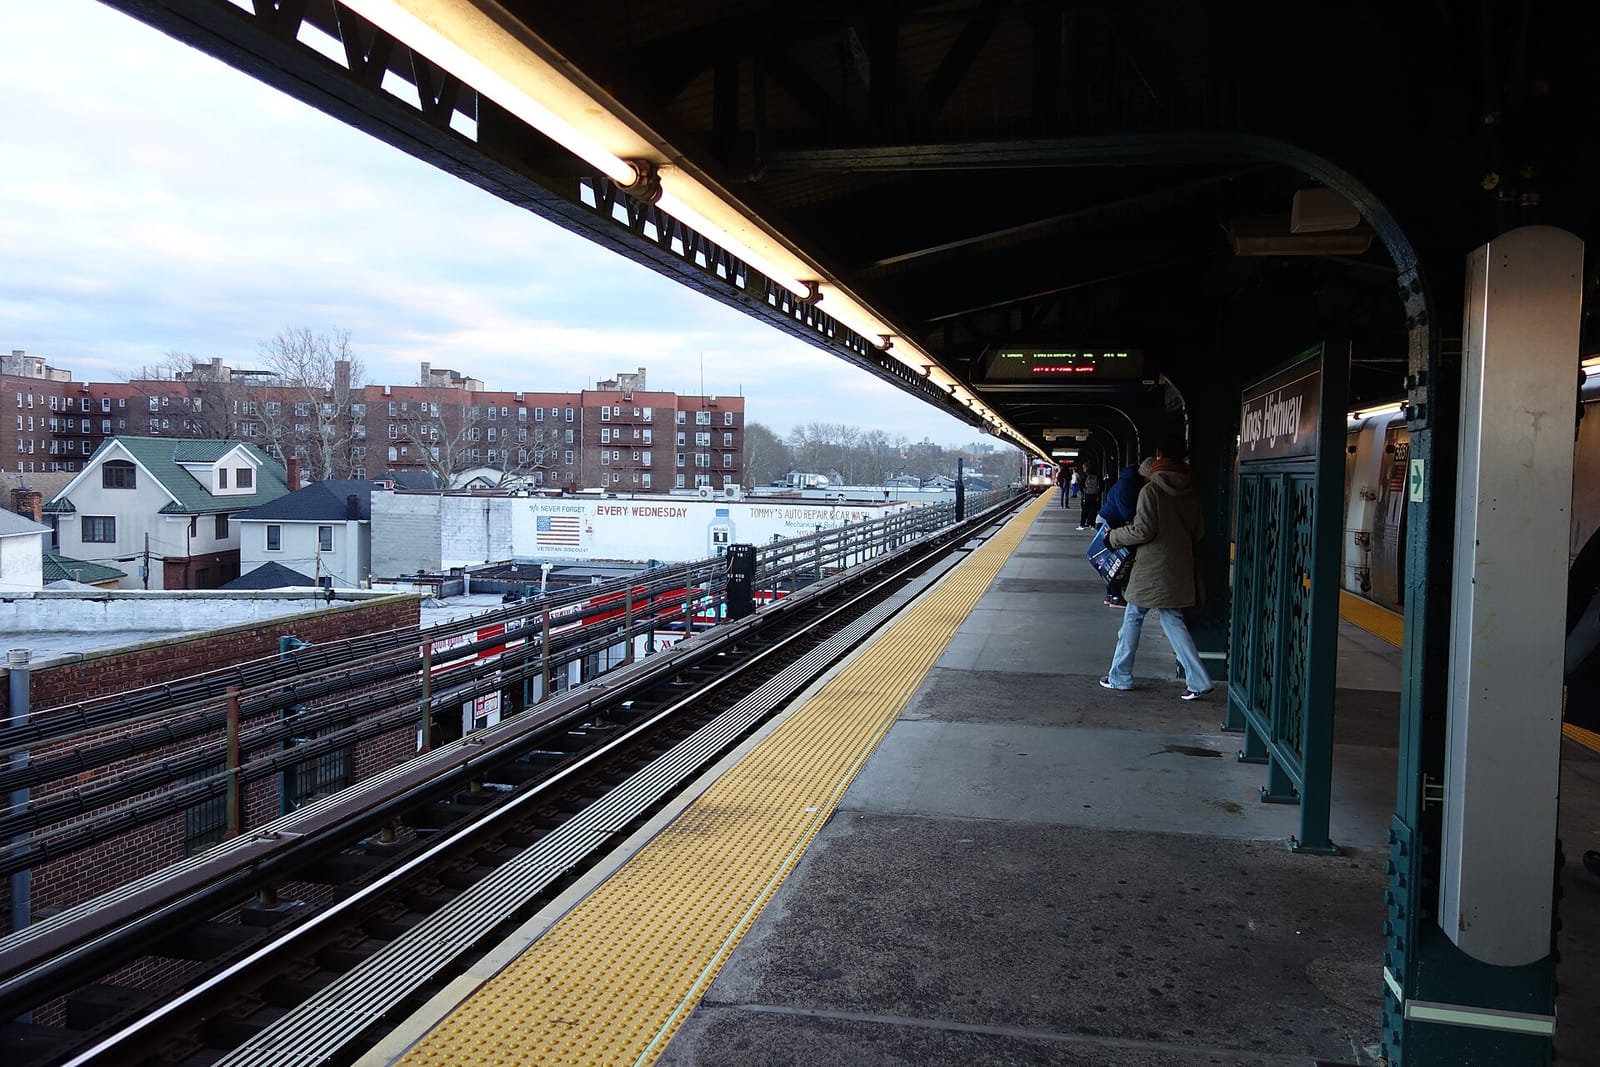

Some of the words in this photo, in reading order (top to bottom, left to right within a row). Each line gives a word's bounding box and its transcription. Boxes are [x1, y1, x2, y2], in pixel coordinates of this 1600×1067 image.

[1241, 404, 1262, 451] Kings
[1262, 390, 1303, 448] Highway
[596, 505, 628, 516] EVERY
[631, 506, 688, 518] WEDNESDAY
[750, 507, 783, 519] TOMMY'S
[784, 508, 804, 520] AUTO
[803, 509, 830, 521] REPAIR
[836, 510, 851, 521] CAR
